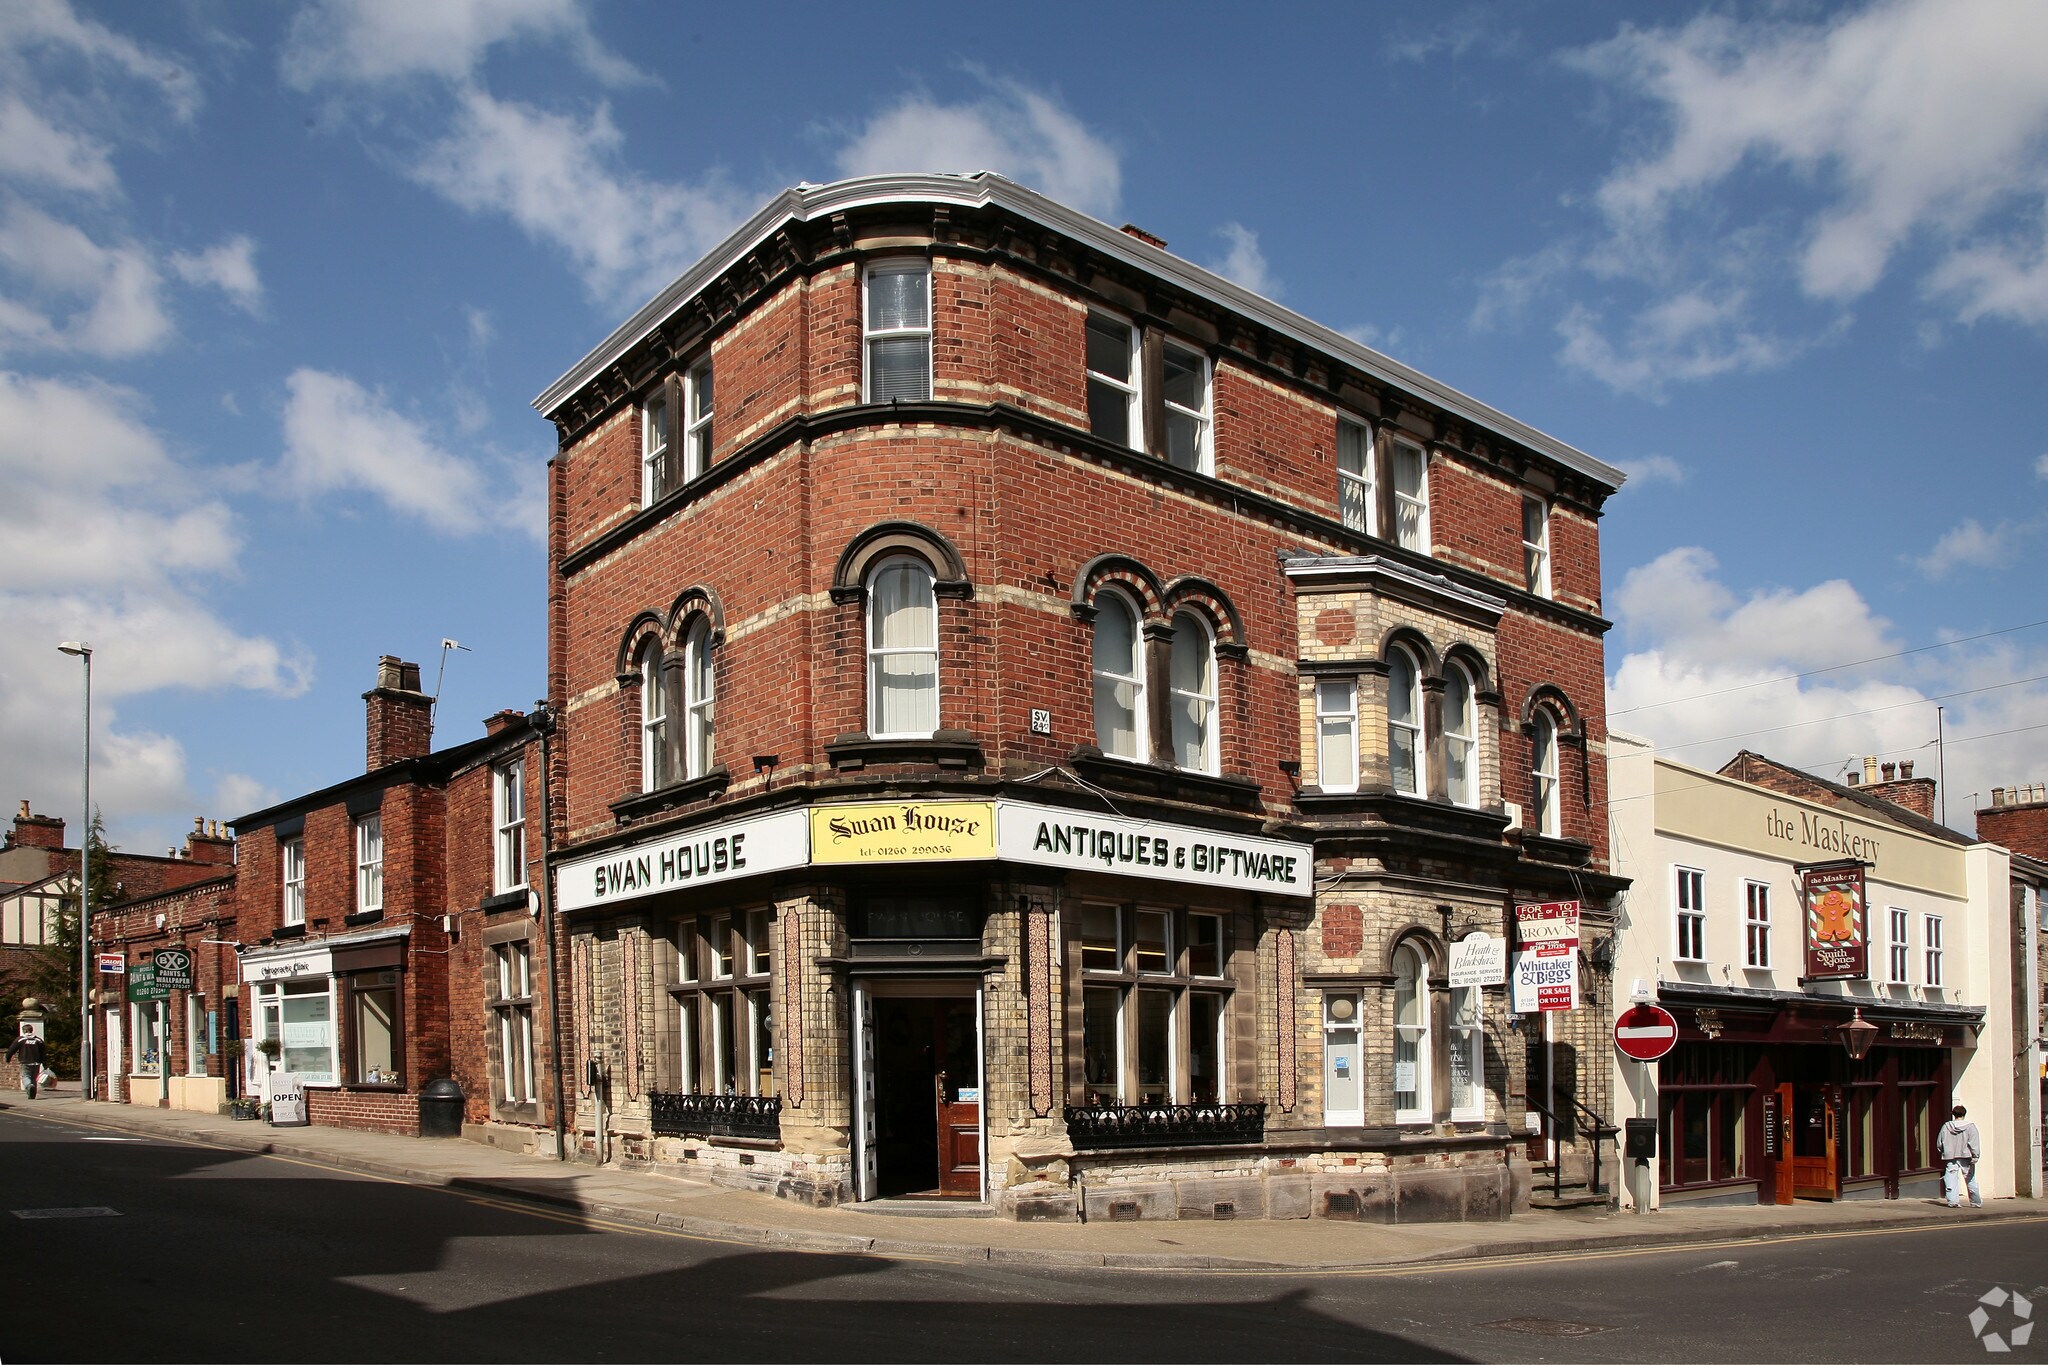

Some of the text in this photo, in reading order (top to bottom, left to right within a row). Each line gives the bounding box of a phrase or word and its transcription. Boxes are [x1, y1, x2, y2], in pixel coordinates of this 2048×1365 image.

[829, 806, 980, 845] Swan House
[1766, 808, 1880, 873] the Maskery
[1033, 822, 1297, 883] ANTIQUES & GIFTWARE
[594, 833, 746, 897] SWAN HOUSE
[1823, 873, 1857, 883] Maskery
[1521, 906, 1541, 914] FOR
[1558, 903, 1572, 911] TO
[1555, 910, 1574, 918] LET
[1519, 913, 1544, 921] SALE
[1520, 925, 1576, 939] BROWN
[1465, 943, 1500, 956] Heath &
[1816, 949, 1848, 962] Smith
[1453, 955, 1498, 970] Blackshaw
[1519, 958, 1573, 972] Whittaker
[1837, 963, 1850, 971] pub
[156, 976, 190, 984] WALLPAPER
[1521, 969, 1571, 985] & Biggs
[1554, 986, 1569, 994] SALE
[273, 1093, 302, 1102] OPEN
